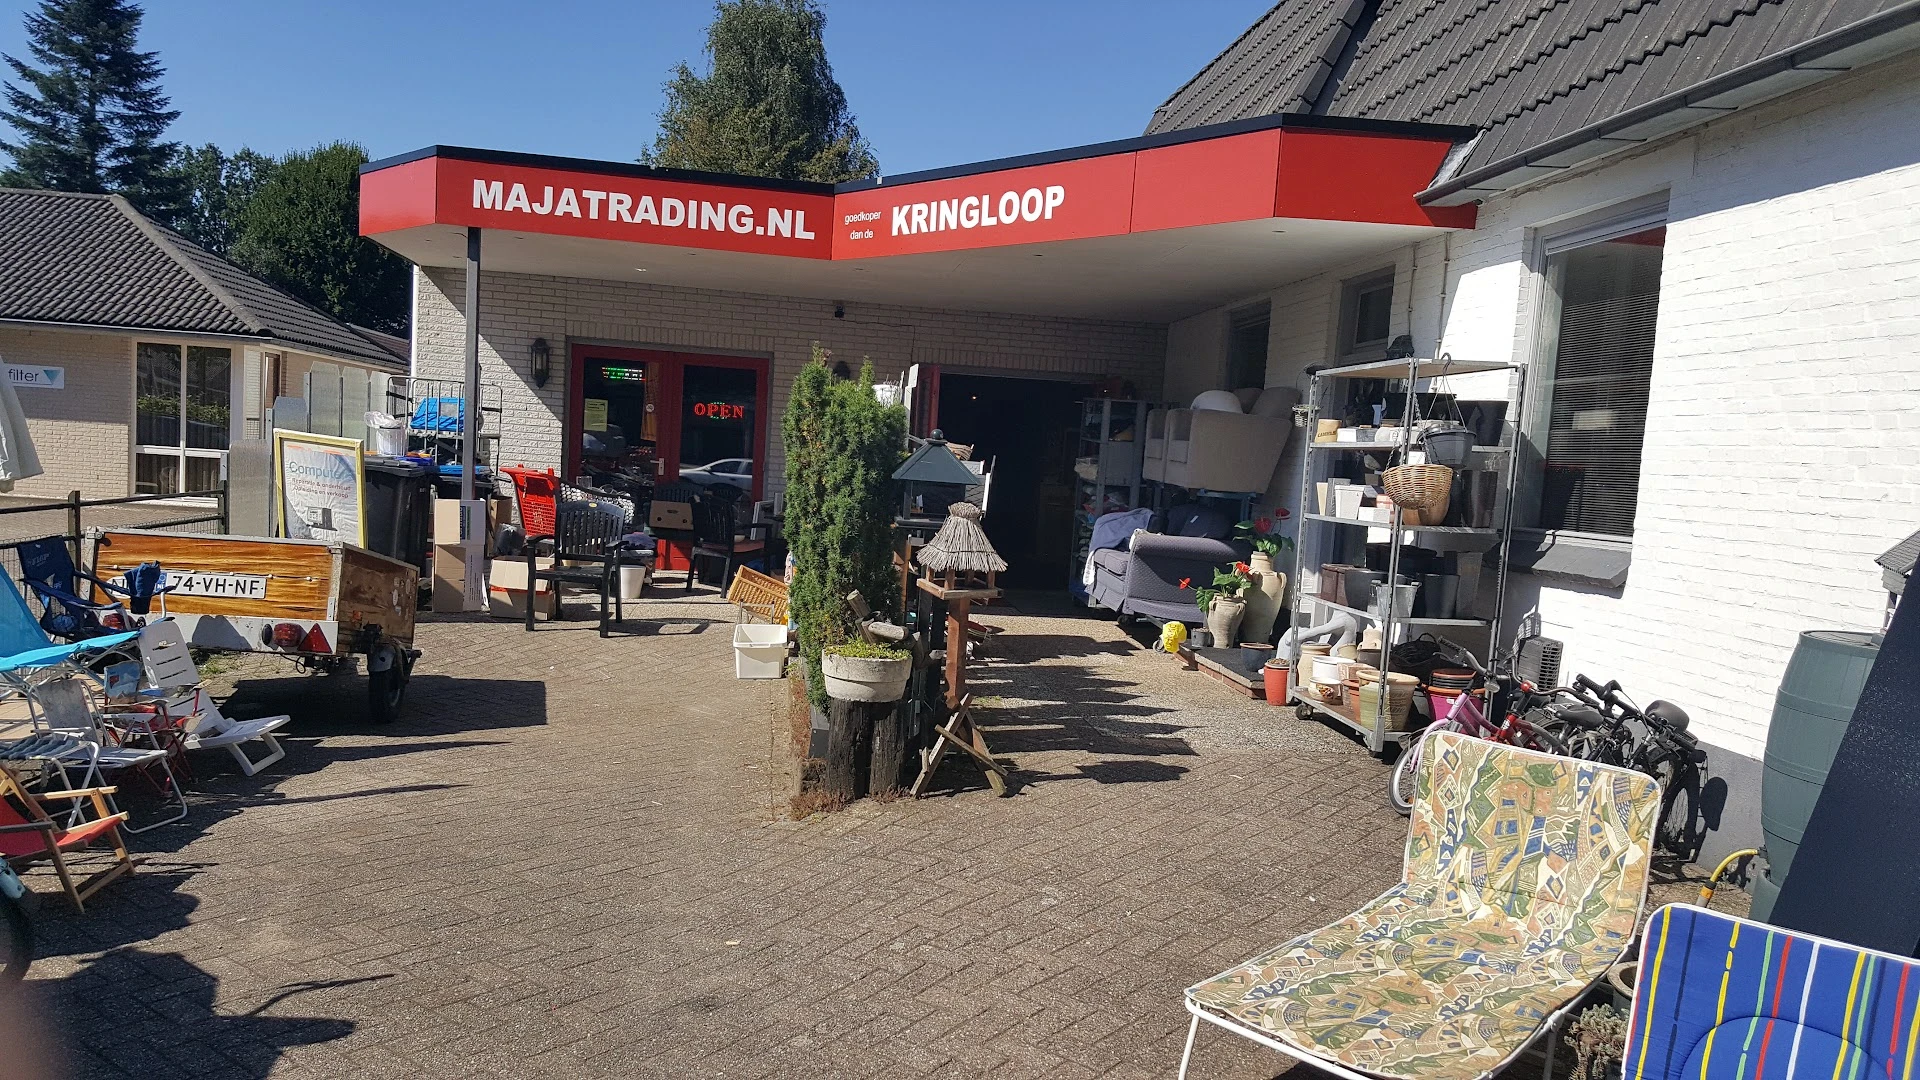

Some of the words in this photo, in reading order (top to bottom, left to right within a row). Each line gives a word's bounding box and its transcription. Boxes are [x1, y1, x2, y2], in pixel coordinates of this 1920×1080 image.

[472, 179, 816, 241] MAJATRADING.NL
[844, 210, 882, 225] goedkoper
[891, 185, 1065, 237] KRINGLOOP
[850, 229, 864, 240] dan
[864, 229, 874, 239] de
[8, 368, 39, 381] filter
[694, 402, 744, 418] OPEN
[173, 576, 260, 595] 74-VH-NF
